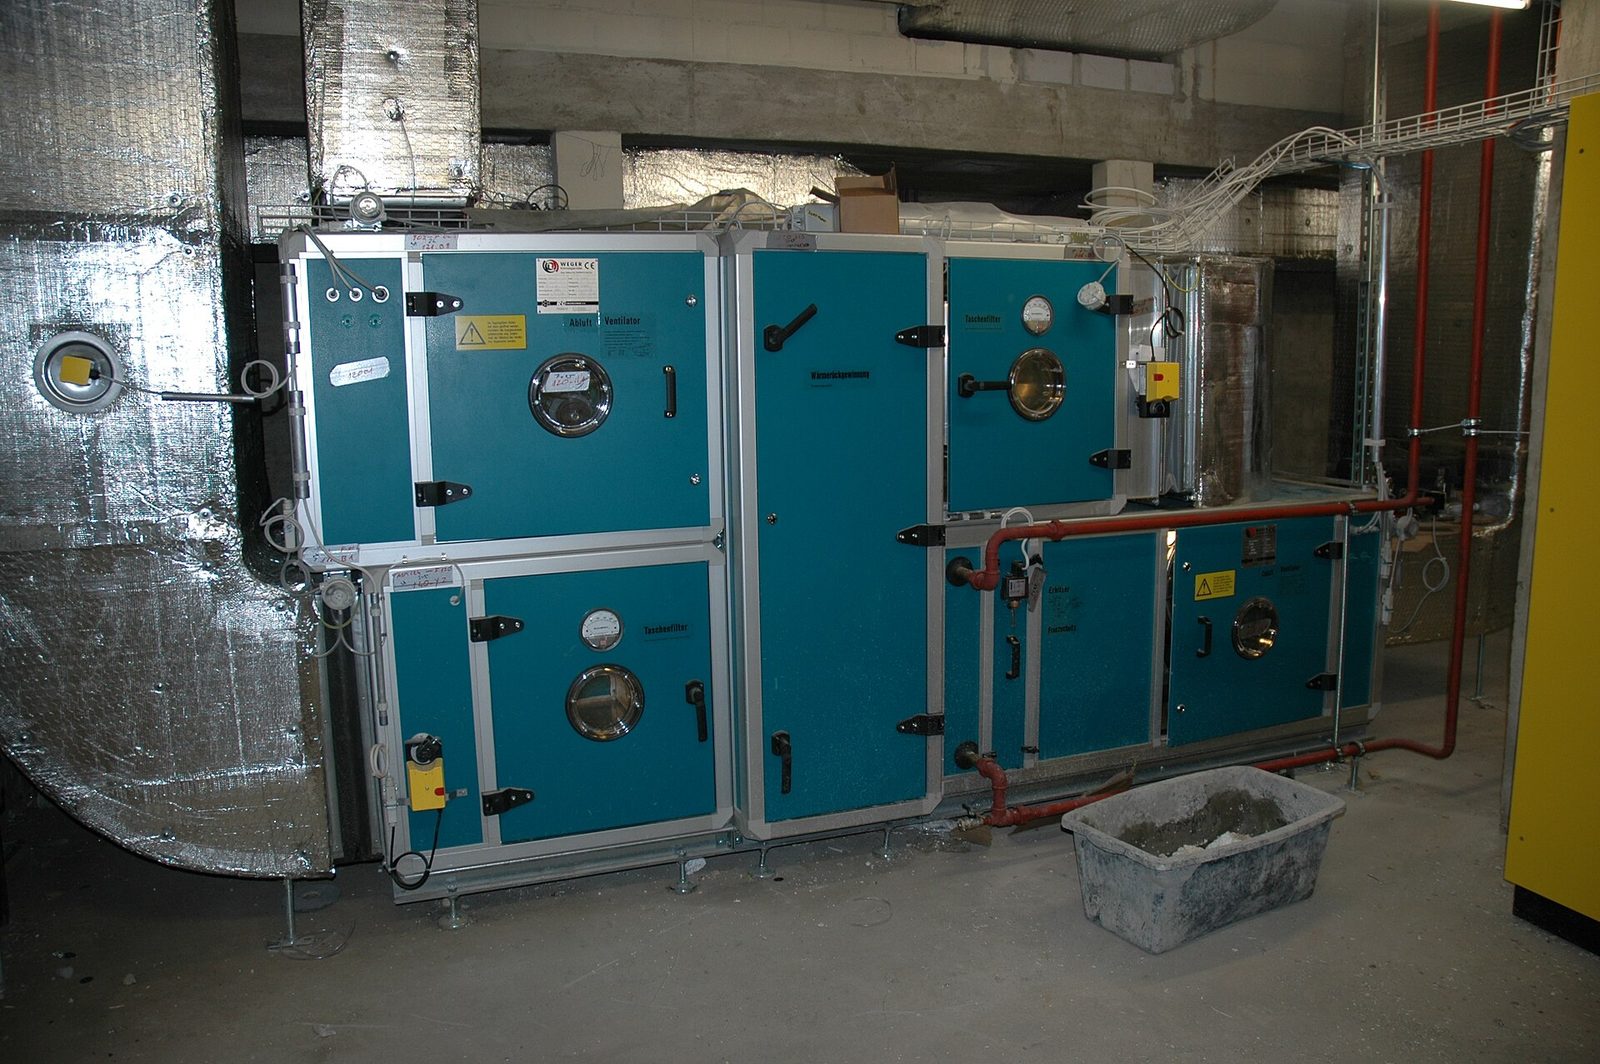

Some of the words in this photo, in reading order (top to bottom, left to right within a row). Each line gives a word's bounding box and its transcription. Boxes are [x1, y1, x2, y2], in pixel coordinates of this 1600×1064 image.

[604, 315, 641, 326] Ventilator
[965, 314, 1001, 323] Taschenfilter
[644, 624, 688, 635] Taschenfilter
